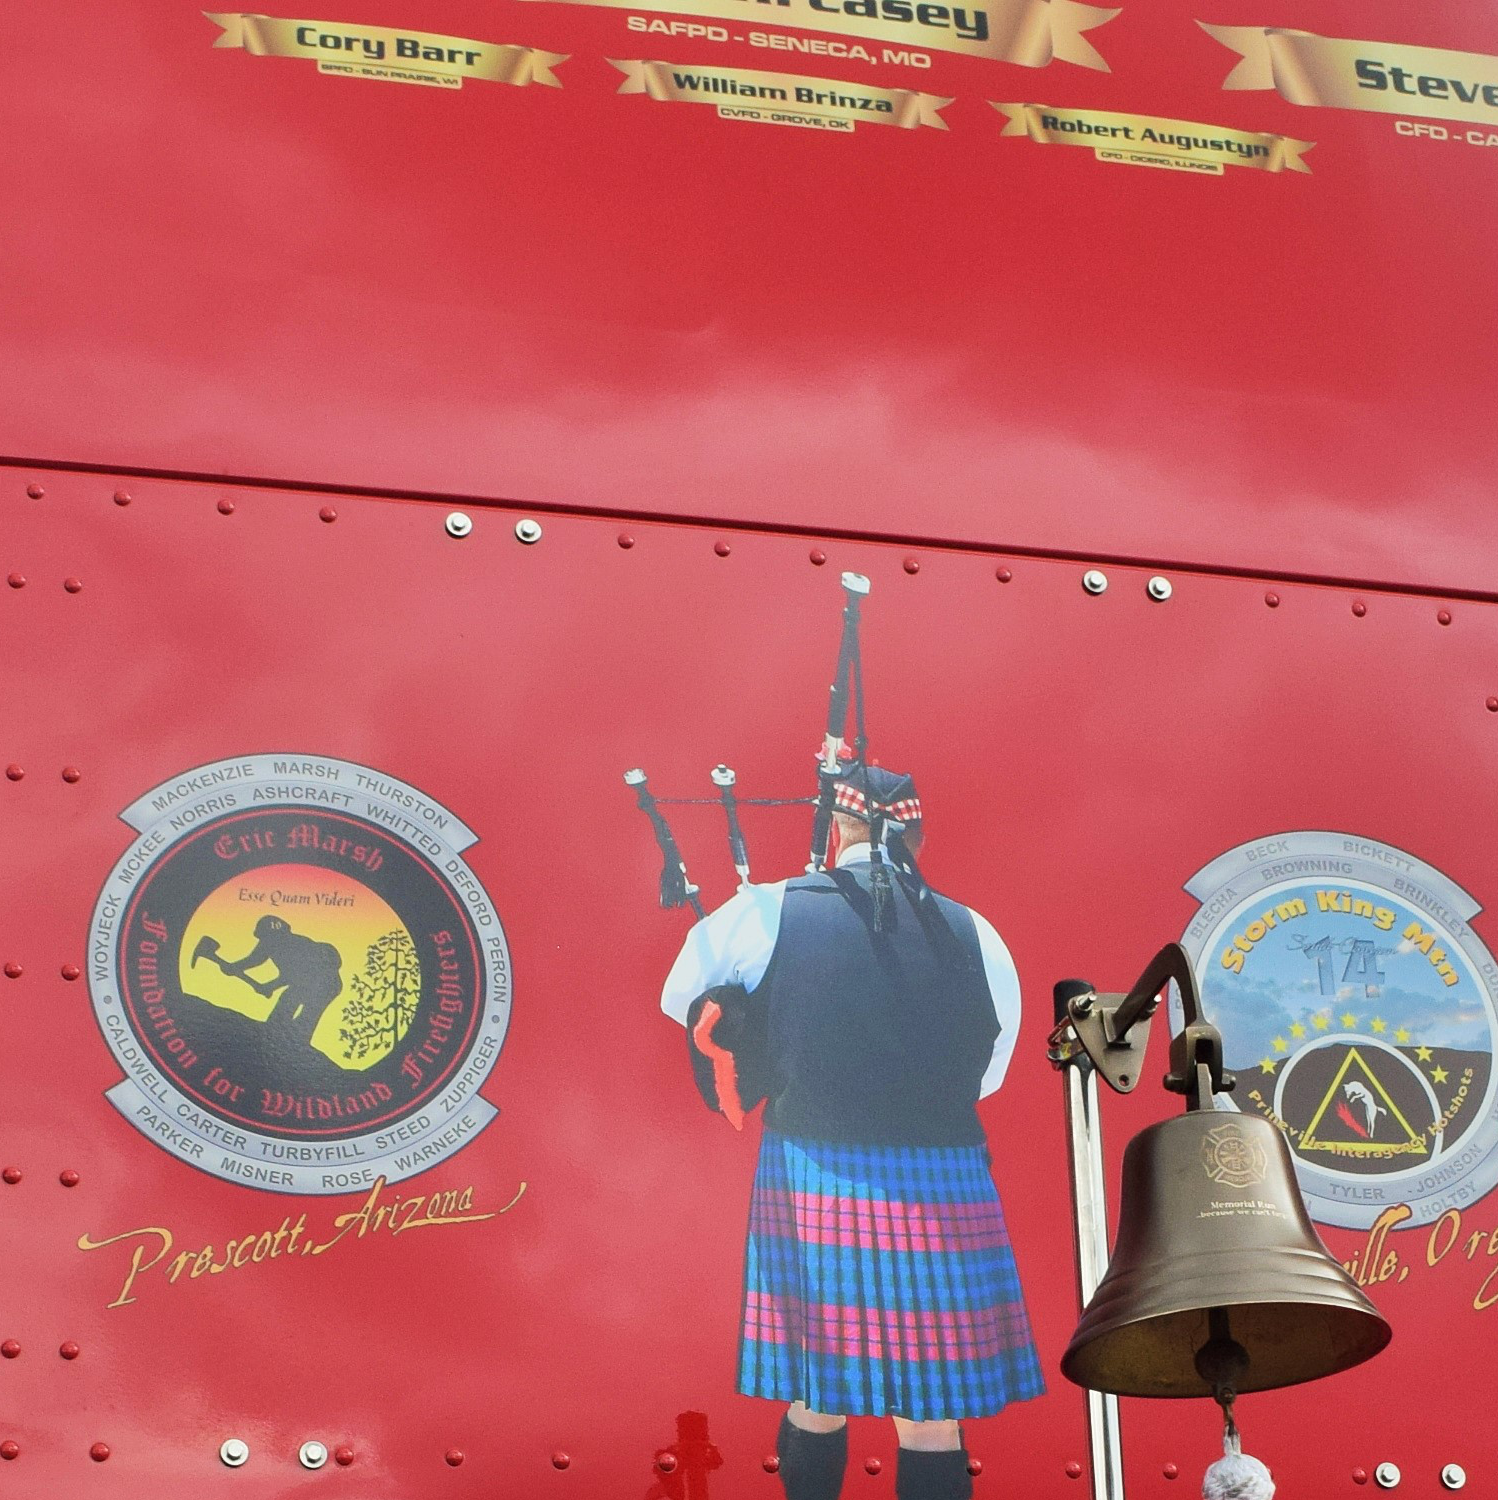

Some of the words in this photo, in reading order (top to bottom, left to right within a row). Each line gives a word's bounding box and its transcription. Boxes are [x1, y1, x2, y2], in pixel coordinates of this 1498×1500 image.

[296, 26, 386, 60] Cory
[396, 37, 482, 66] Barr
[627, 16, 729, 42] SAFPD
[749, 32, 877, 65] SENECA,
[882, 50, 931, 69] MO
[362, 68, 388, 77] SUN
[673, 73, 788, 102] William
[795, 87, 894, 114] Brinza
[720, 108, 761, 121] CVFD
[770, 113, 827, 129] GROVE,
[829, 119, 850, 131] OK
[1041, 114, 1135, 141] Robert
[1140, 128, 1270, 158] Augustyn
[1395, 120, 1448, 141] CFD
[151, 764, 255, 812] MACKENZIE
[273, 761, 339, 781] MARSH
[355, 773, 449, 830] THURSTON
[213, 829, 276, 860] Eric
[287, 824, 384, 872] Marsh
[1244, 840, 1290, 862] BECK
[1342, 840, 1416, 871] BICKETT
[94, 894, 122, 982] WOYJECK
[118, 830, 166, 885] MCKEE
[169, 793, 237, 831] NORRIS
[252, 786, 354, 808] ASHCRAFT
[366, 803, 442, 857] WHITTED
[445, 859, 493, 927] DEFORD
[486, 936, 507, 1004] PERCIN
[238, 888, 265, 902] Esse
[270, 889, 311, 907] Quam
[314, 891, 356, 907] Videri
[1189, 887, 1238, 940] BLECHA
[1260, 860, 1353, 881] BROWNING
[1393, 878, 1471, 939] BRINKLEY
[1221, 897, 1308, 975] Storm
[1315, 889, 1397, 931] King
[1402, 921, 1460, 988] Mtn
[1303, 935, 1386, 999] 14
[138, 911, 199, 1069] Foundation
[203, 1067, 245, 1102] for
[261, 1082, 393, 1119] Wildland
[105, 1014, 169, 1104] CALDWELL
[176, 1103, 247, 1150] CARTER
[261, 1141, 365, 1161] TURBYFILL
[374, 1114, 431, 1150] STEED
[439, 1035, 498, 1114] ZUPPIGER
[1248, 1089, 1327, 1150] Prineville
[1331, 1132, 1428, 1159] Interagency
[1427, 1067, 1475, 1137] Hotshots
[136, 1105, 205, 1159] PARKER
[220, 1156, 294, 1186] MISNER
[321, 1168, 375, 1188] ROSE
[394, 1115, 477, 1172] WARNEKE
[1210, 1200, 1256, 1210] Memorial
[1329, 1183, 1386, 1200] TYLER
[1419, 1181, 1477, 1218] HOLTBY
[77, 1213, 312, 1309] Prescott,
[312, 1174, 527, 1255] Arizona
